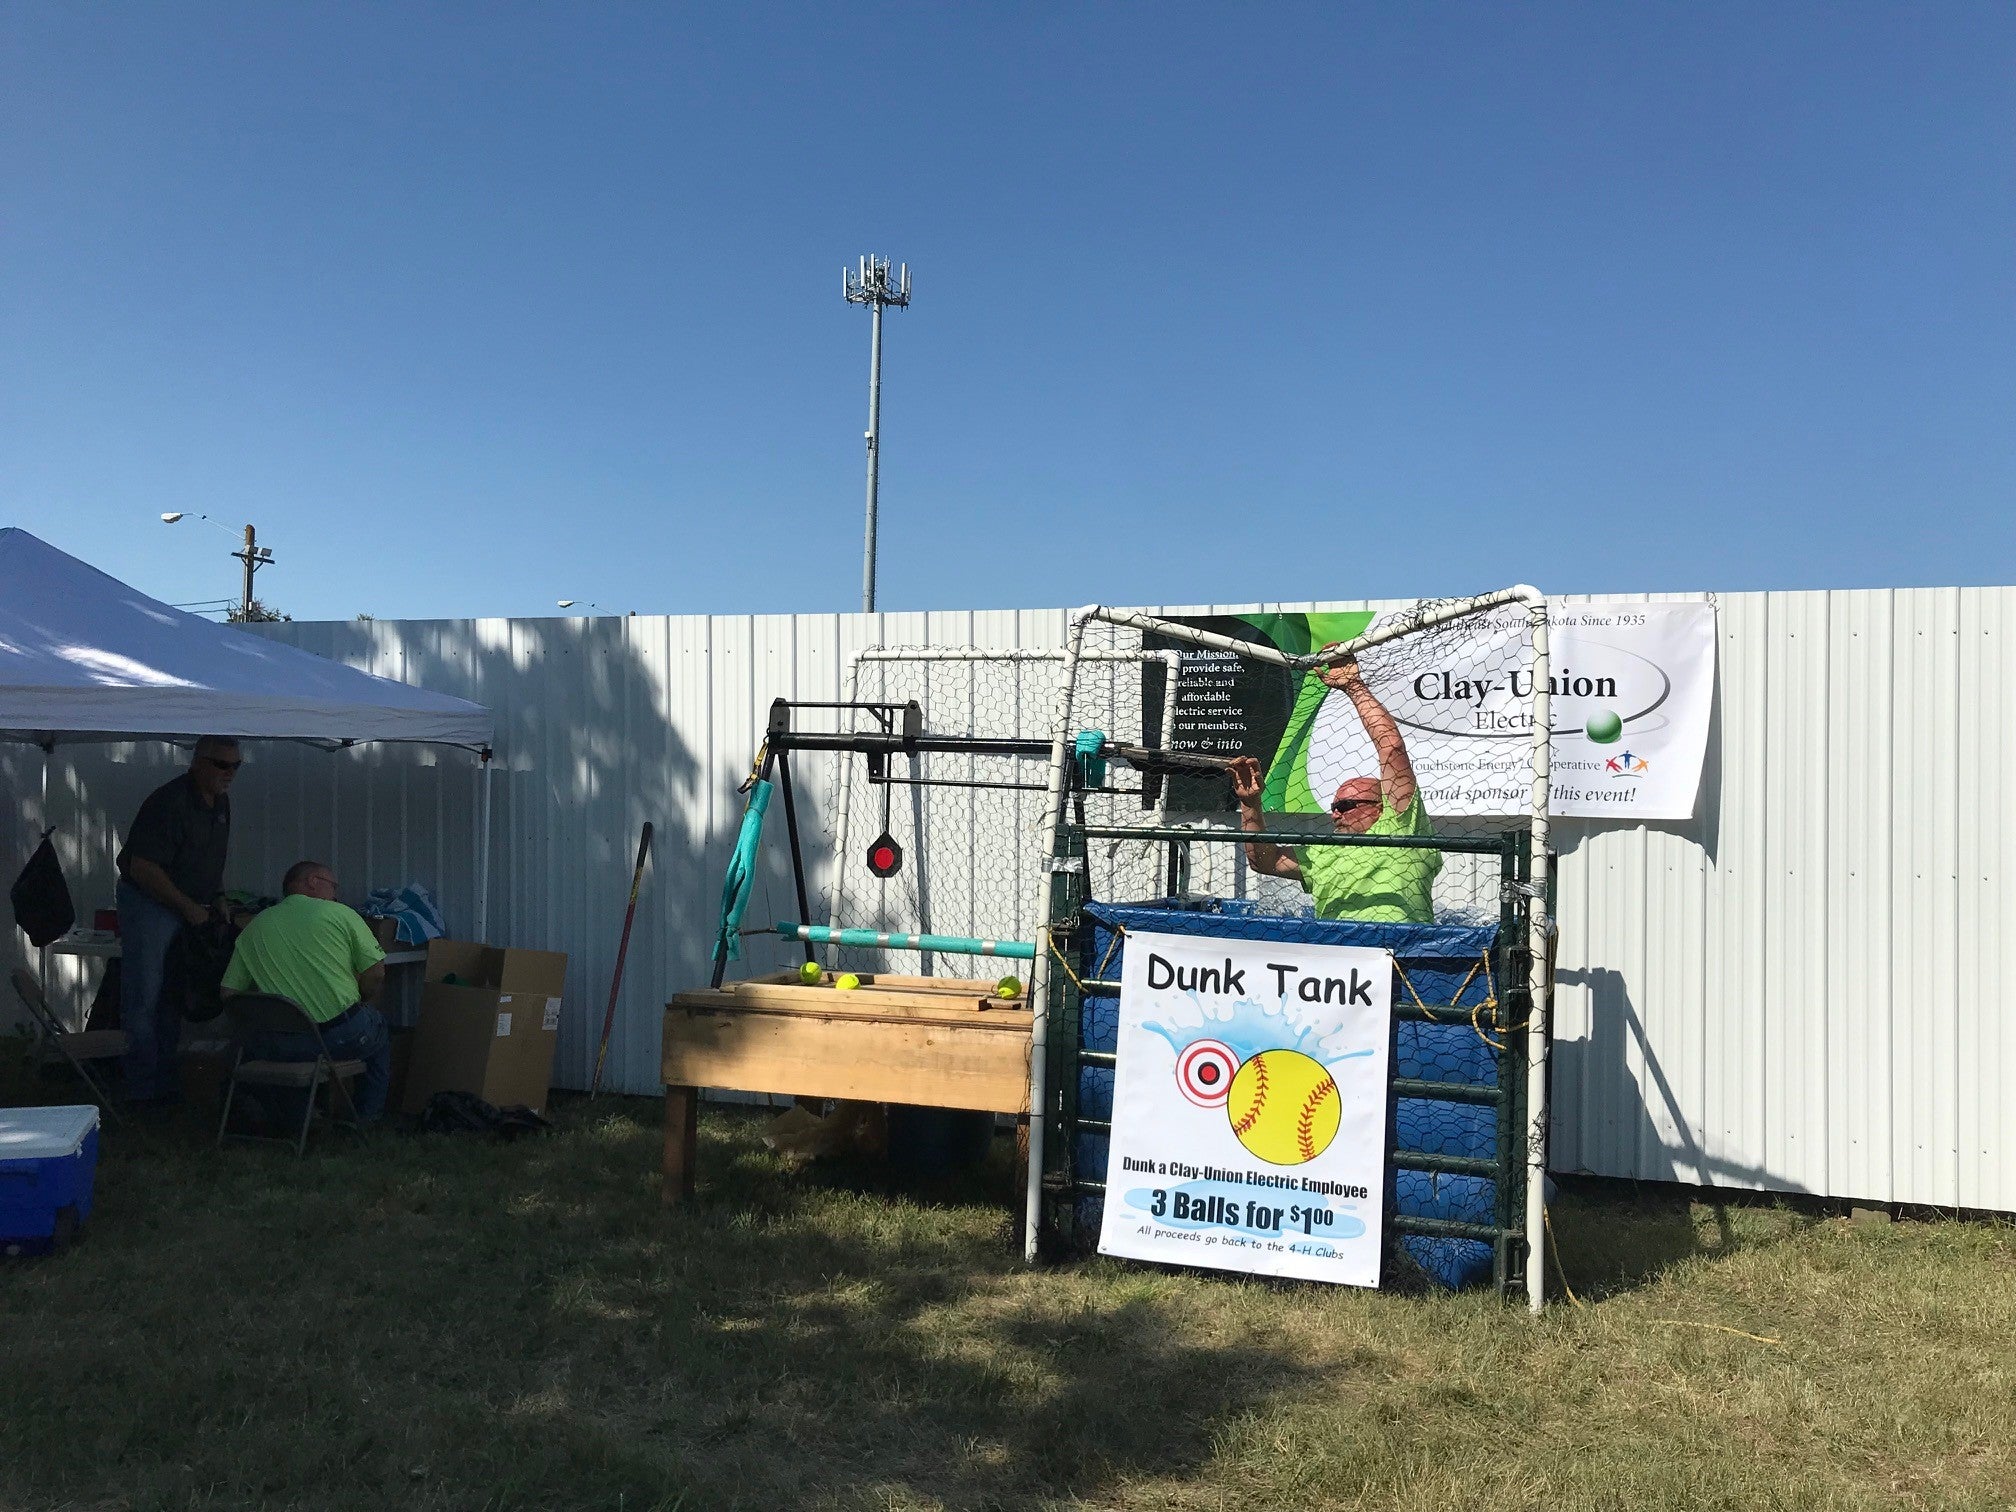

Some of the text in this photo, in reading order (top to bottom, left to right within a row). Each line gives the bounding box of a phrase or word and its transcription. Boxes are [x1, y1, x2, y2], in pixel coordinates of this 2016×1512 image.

[1548, 615, 1577, 626] kota
[1580, 614, 1611, 626] Since
[1616, 614, 1646, 626] 1935
[1182, 662, 1245, 675] provide safe,
[1178, 677, 1235, 687] reliable and
[1181, 691, 1231, 701] affordable
[1175, 705, 1243, 716] lectric service
[1178, 722, 1196, 730] our
[1198, 720, 1247, 731] members,
[1476, 711, 1558, 730] Electrc
[1171, 737, 1243, 750] now & into
[1526, 757, 1601, 771] Cperative
[1423, 785, 1461, 800] roud
[1466, 788, 1528, 804] sponsor
[1553, 785, 1581, 801] this
[1585, 787, 1636, 802] event!
[1147, 952, 1373, 1007] Dunk Tank
[1122, 1156, 1368, 1199] Dunk a Clay-Union Electric Employee
[1150, 1189, 1167, 1217] 3
[1173, 1191, 1240, 1226] Balls
[1246, 1201, 1284, 1231] for
[1137, 1225, 1344, 1260] All proceeds go back to the 4-H Clubs
